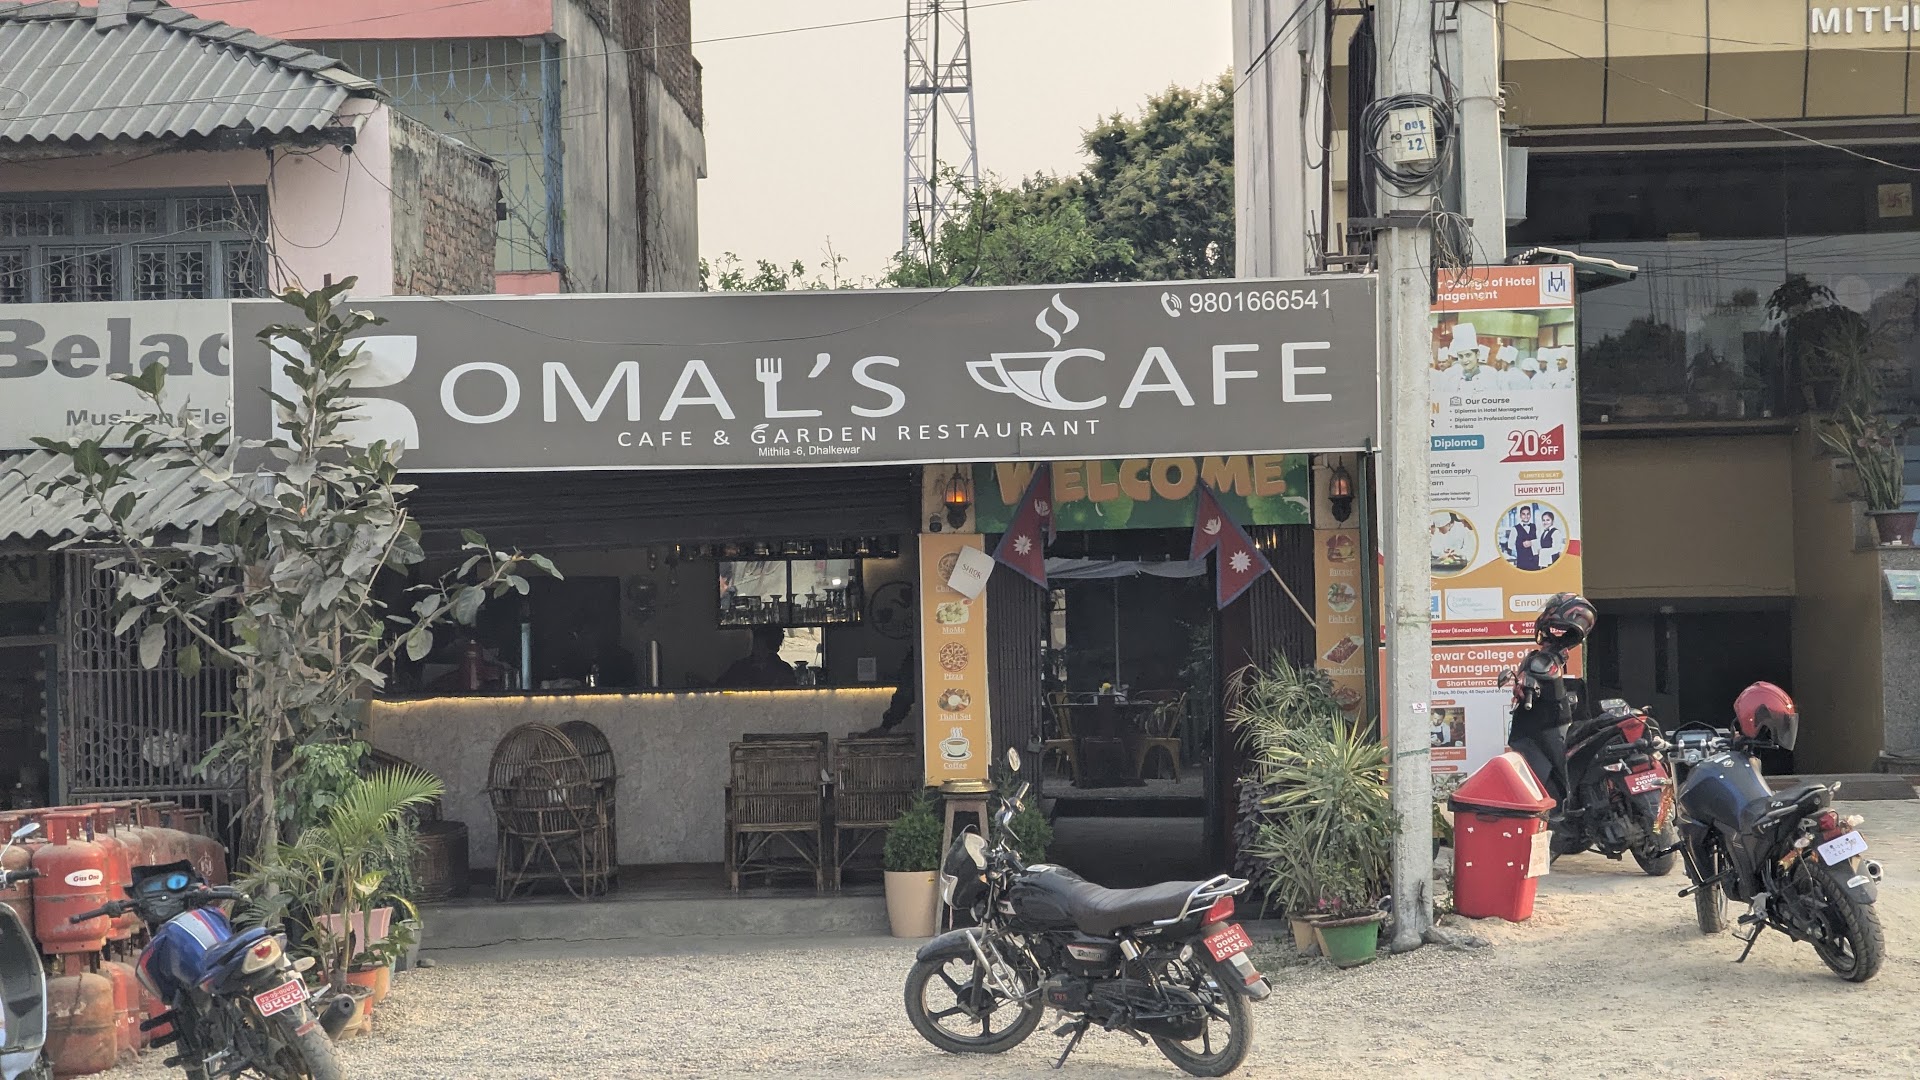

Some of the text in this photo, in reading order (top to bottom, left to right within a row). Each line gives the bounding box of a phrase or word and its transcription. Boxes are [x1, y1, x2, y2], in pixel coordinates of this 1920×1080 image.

[1812, 5, 1920, 34] MITHI
[1407, 138, 1424, 151] 12
[1445, 279, 1489, 291] College
[1492, 278, 1503, 287] of
[1505, 276, 1536, 287] Hotel
[1189, 289, 1331, 313] 9801666541
[1040, 341, 1333, 411] CAFE
[1481, 397, 1510, 405] Course
[617, 419, 1100, 448] CAFE & GARDEN RESTAURANT
[1434, 438, 1478, 450] Diploma
[758, 446, 789, 457] Mithila
[808, 445, 861, 457] Dhalkewar
[1540, 446, 1559, 455] OFF
[1453, 468, 1472, 476] apply
[994, 454, 1287, 505] WELCOME
[1517, 486, 1544, 494] HURRY
[1514, 599, 1542, 607] Enroll
[943, 626, 966, 634] MoMo
[1467, 650, 1514, 663] College
[1517, 649, 1529, 659] of
[943, 761, 968, 770] Coffee
